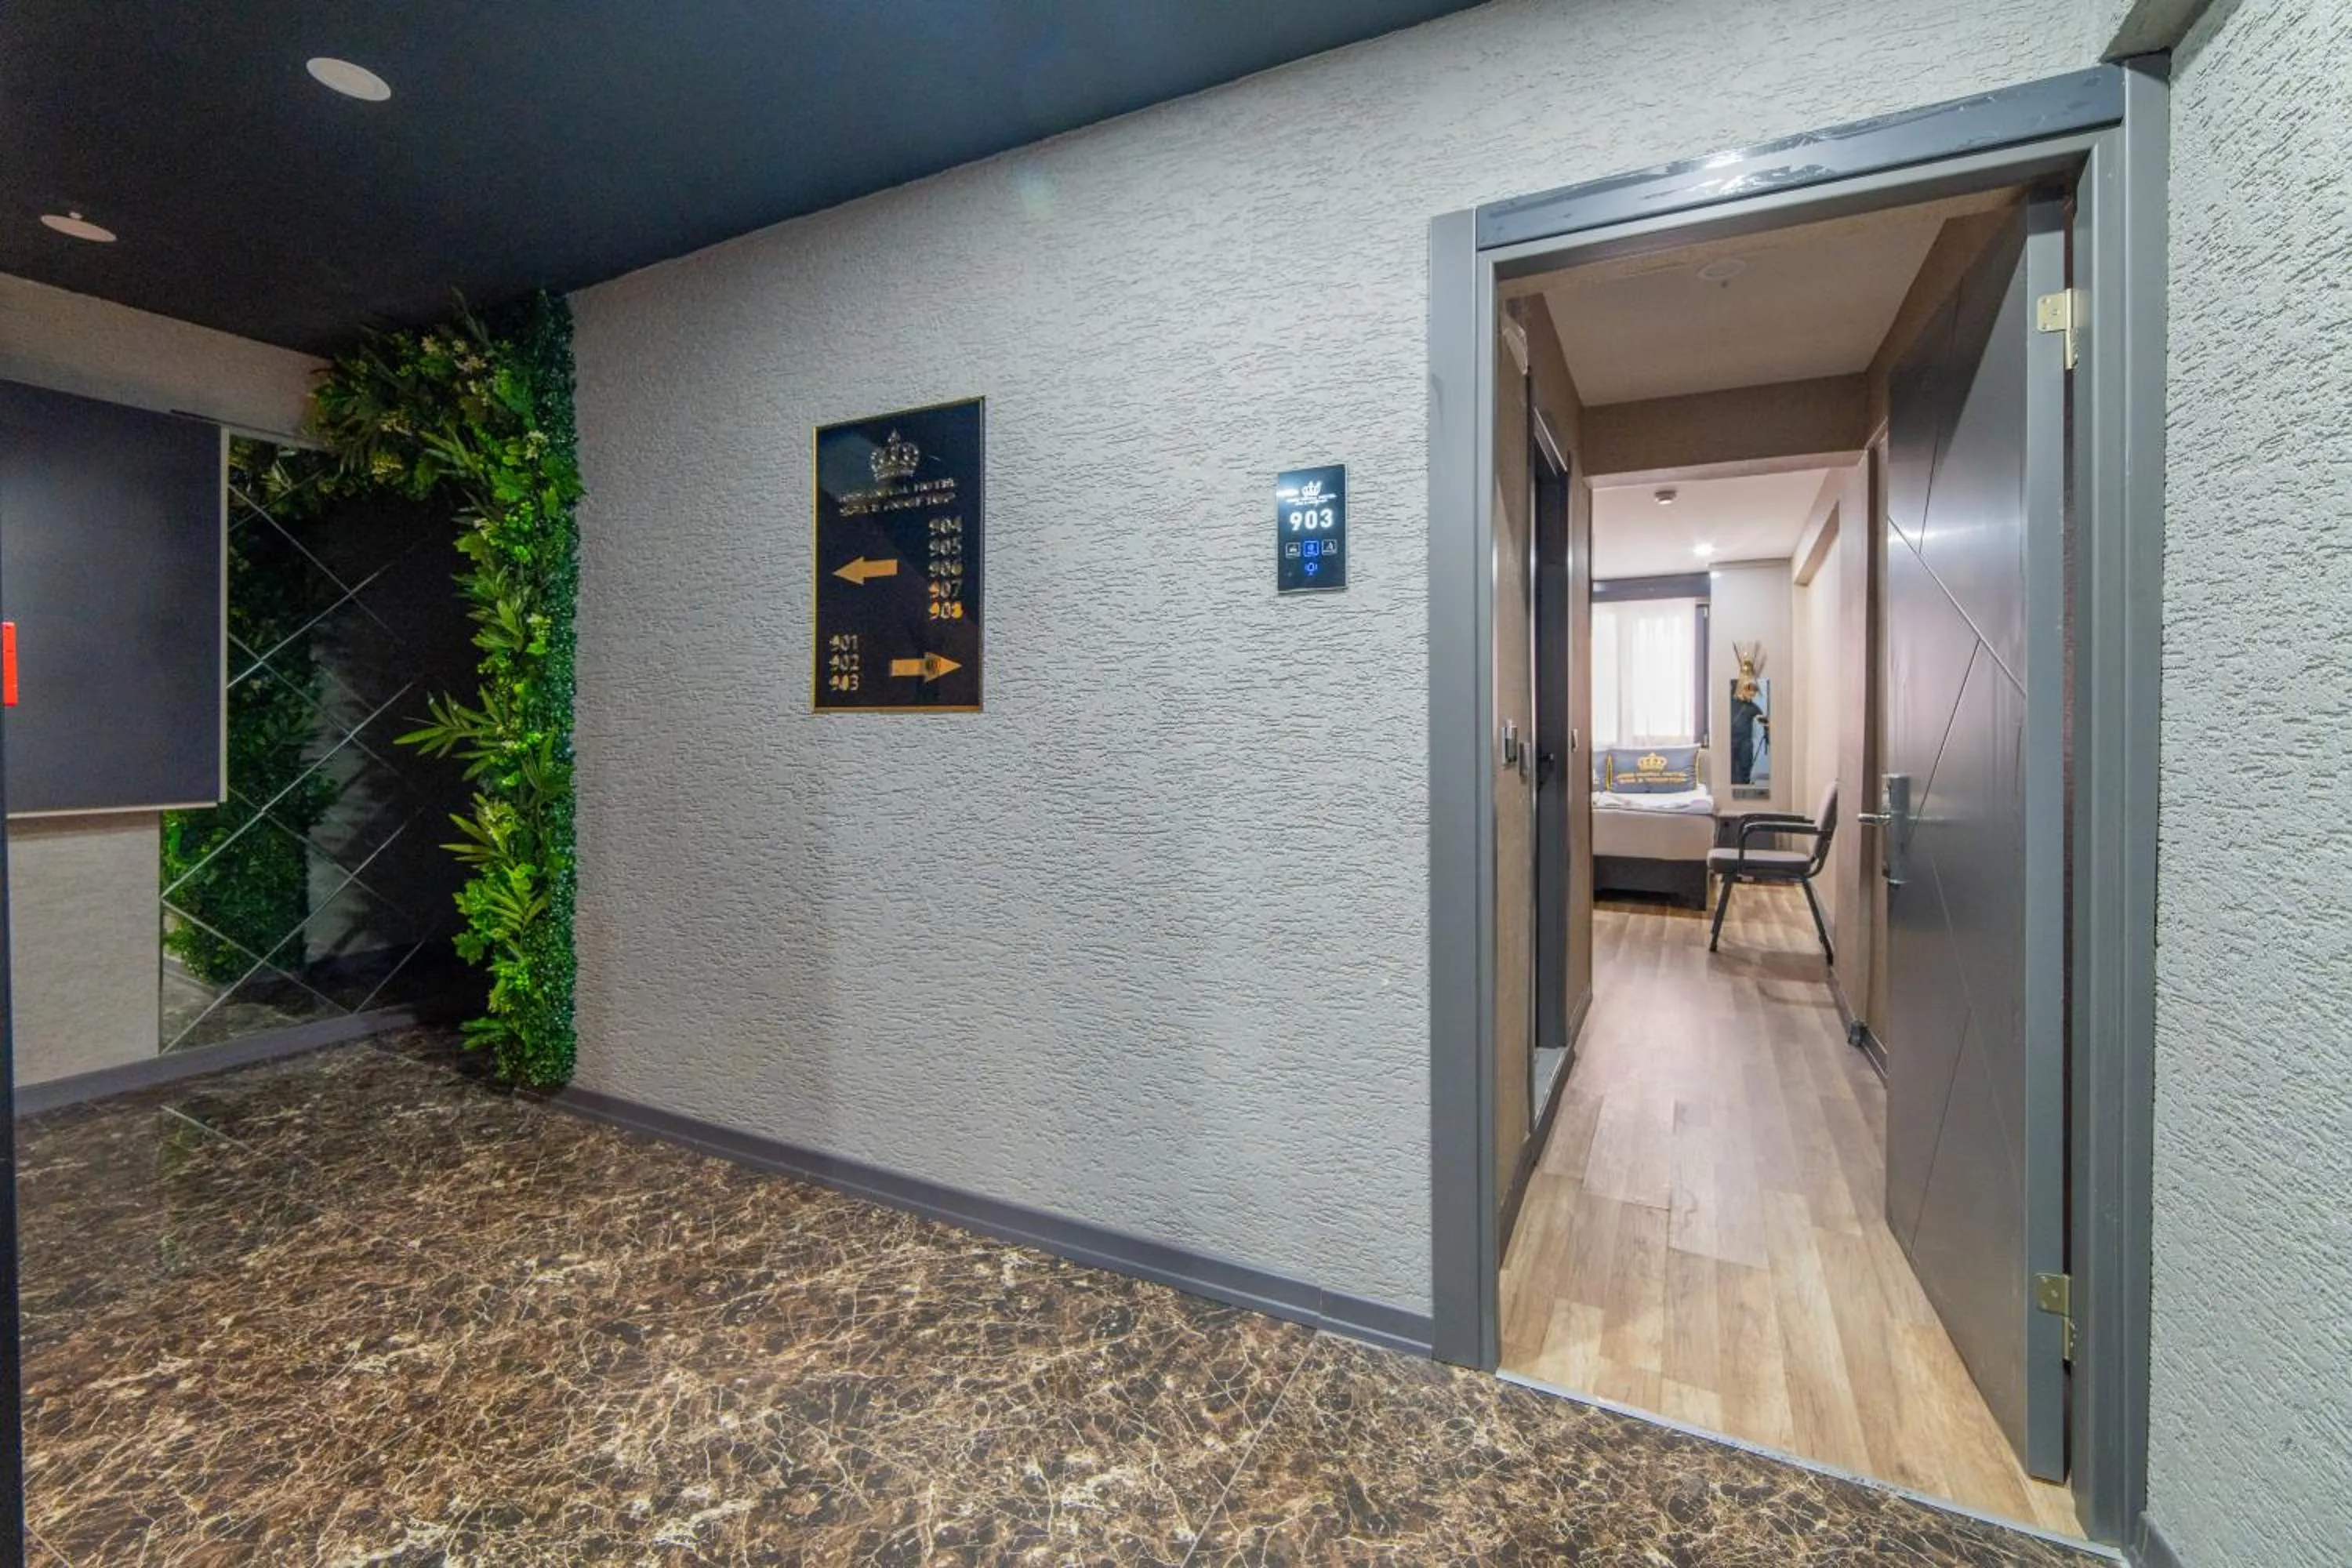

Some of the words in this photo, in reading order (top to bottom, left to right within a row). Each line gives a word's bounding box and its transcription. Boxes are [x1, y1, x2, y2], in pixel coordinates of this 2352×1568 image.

[928, 517, 963, 535] 904
[1289, 509, 1334, 531] 903
[928, 536, 963, 557] 905
[928, 579, 963, 598] 907
[829, 634, 858, 652] 901
[829, 654, 859, 671] 902
